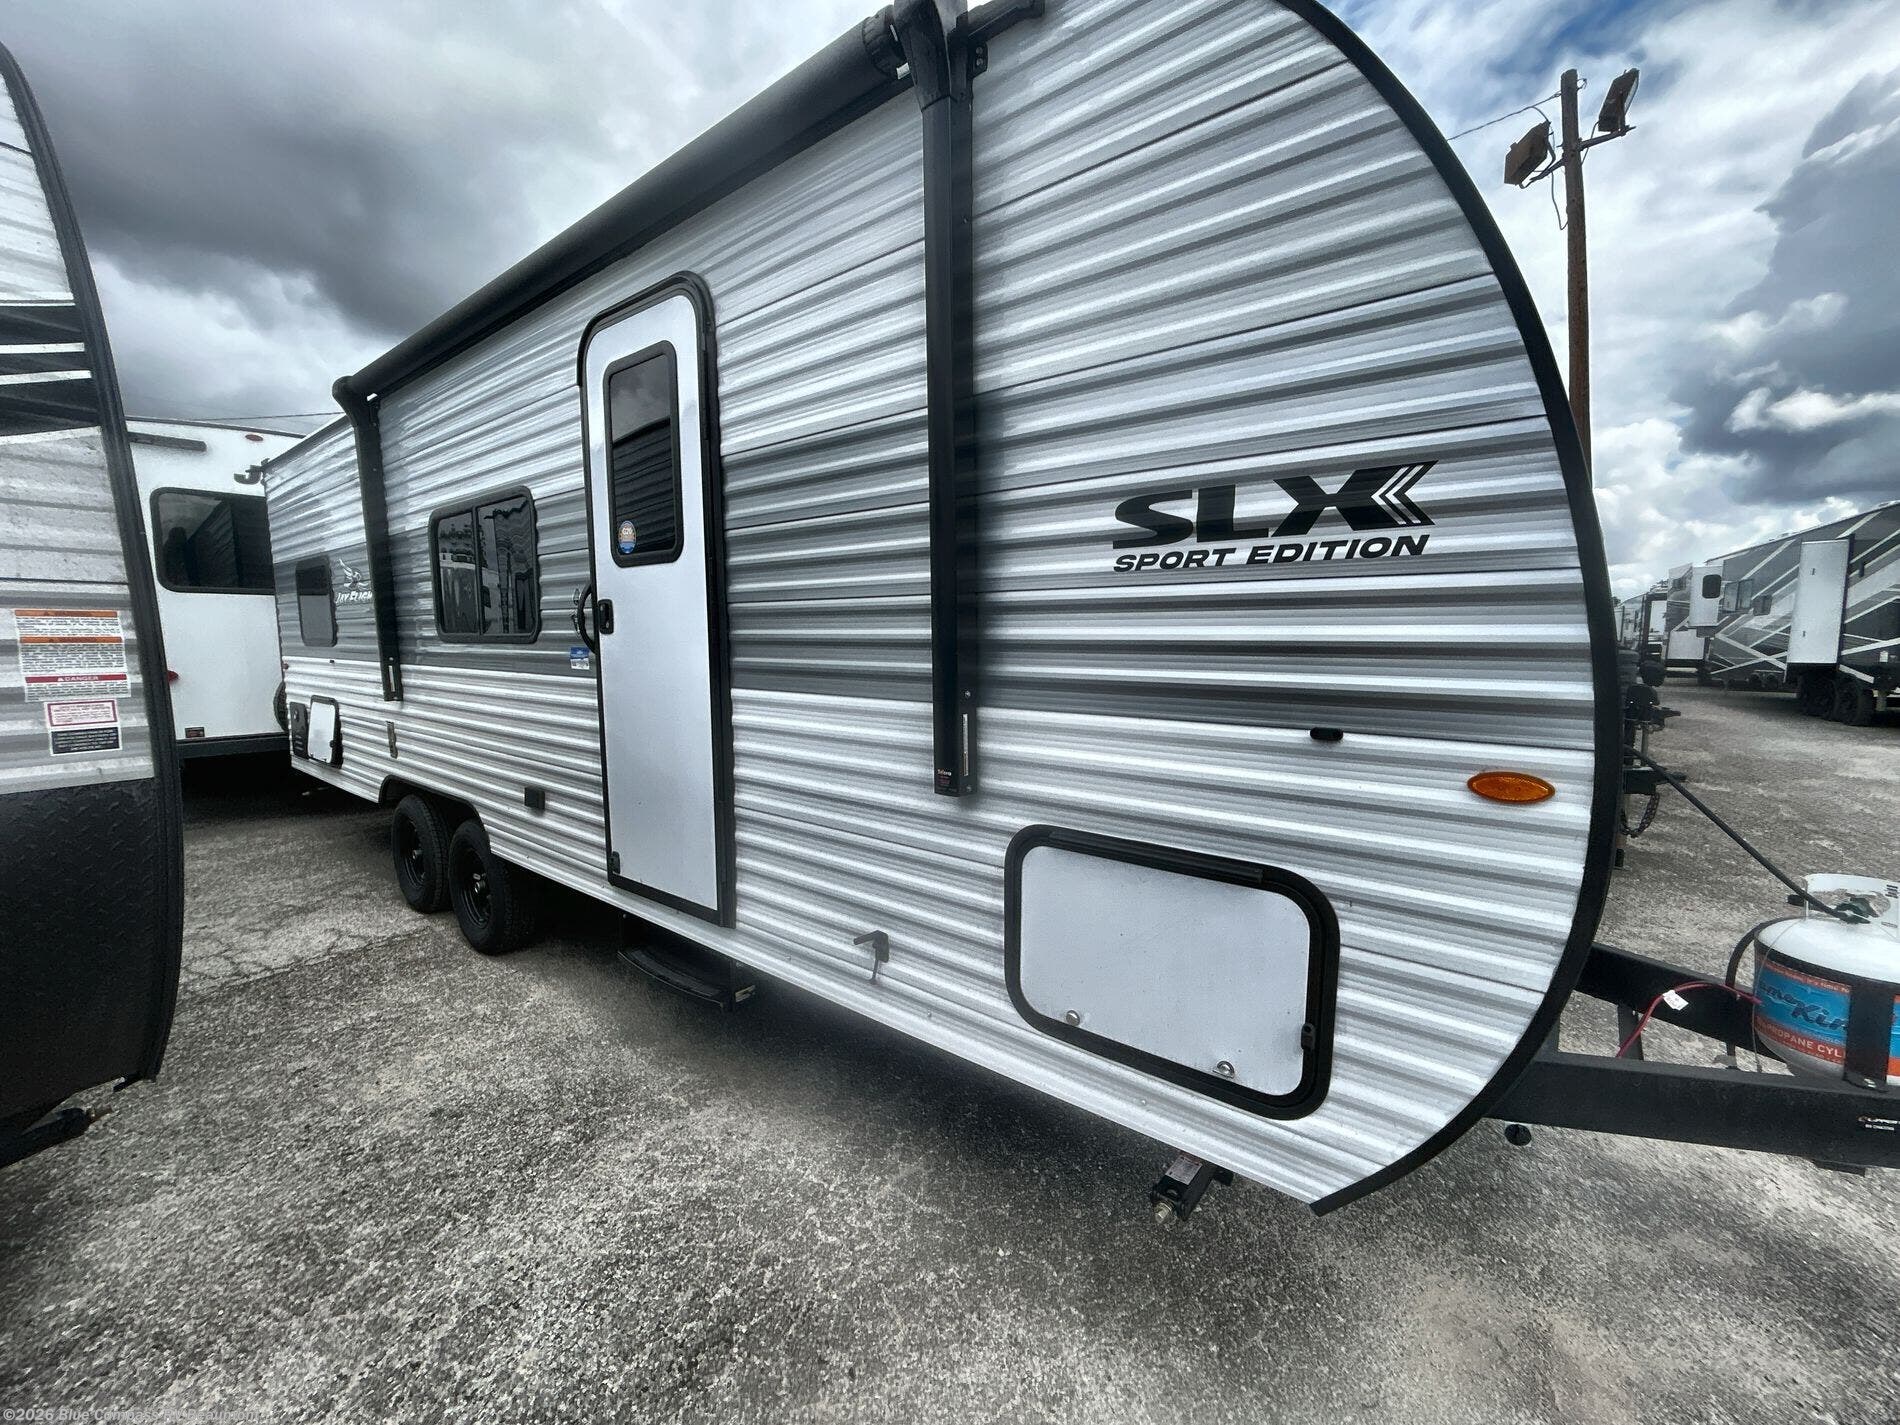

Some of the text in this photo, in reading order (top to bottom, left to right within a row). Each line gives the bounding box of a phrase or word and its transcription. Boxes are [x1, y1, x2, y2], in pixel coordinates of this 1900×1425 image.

[1112, 459, 1439, 549] SLX
[1113, 534, 1430, 573] SPORT EDITION
